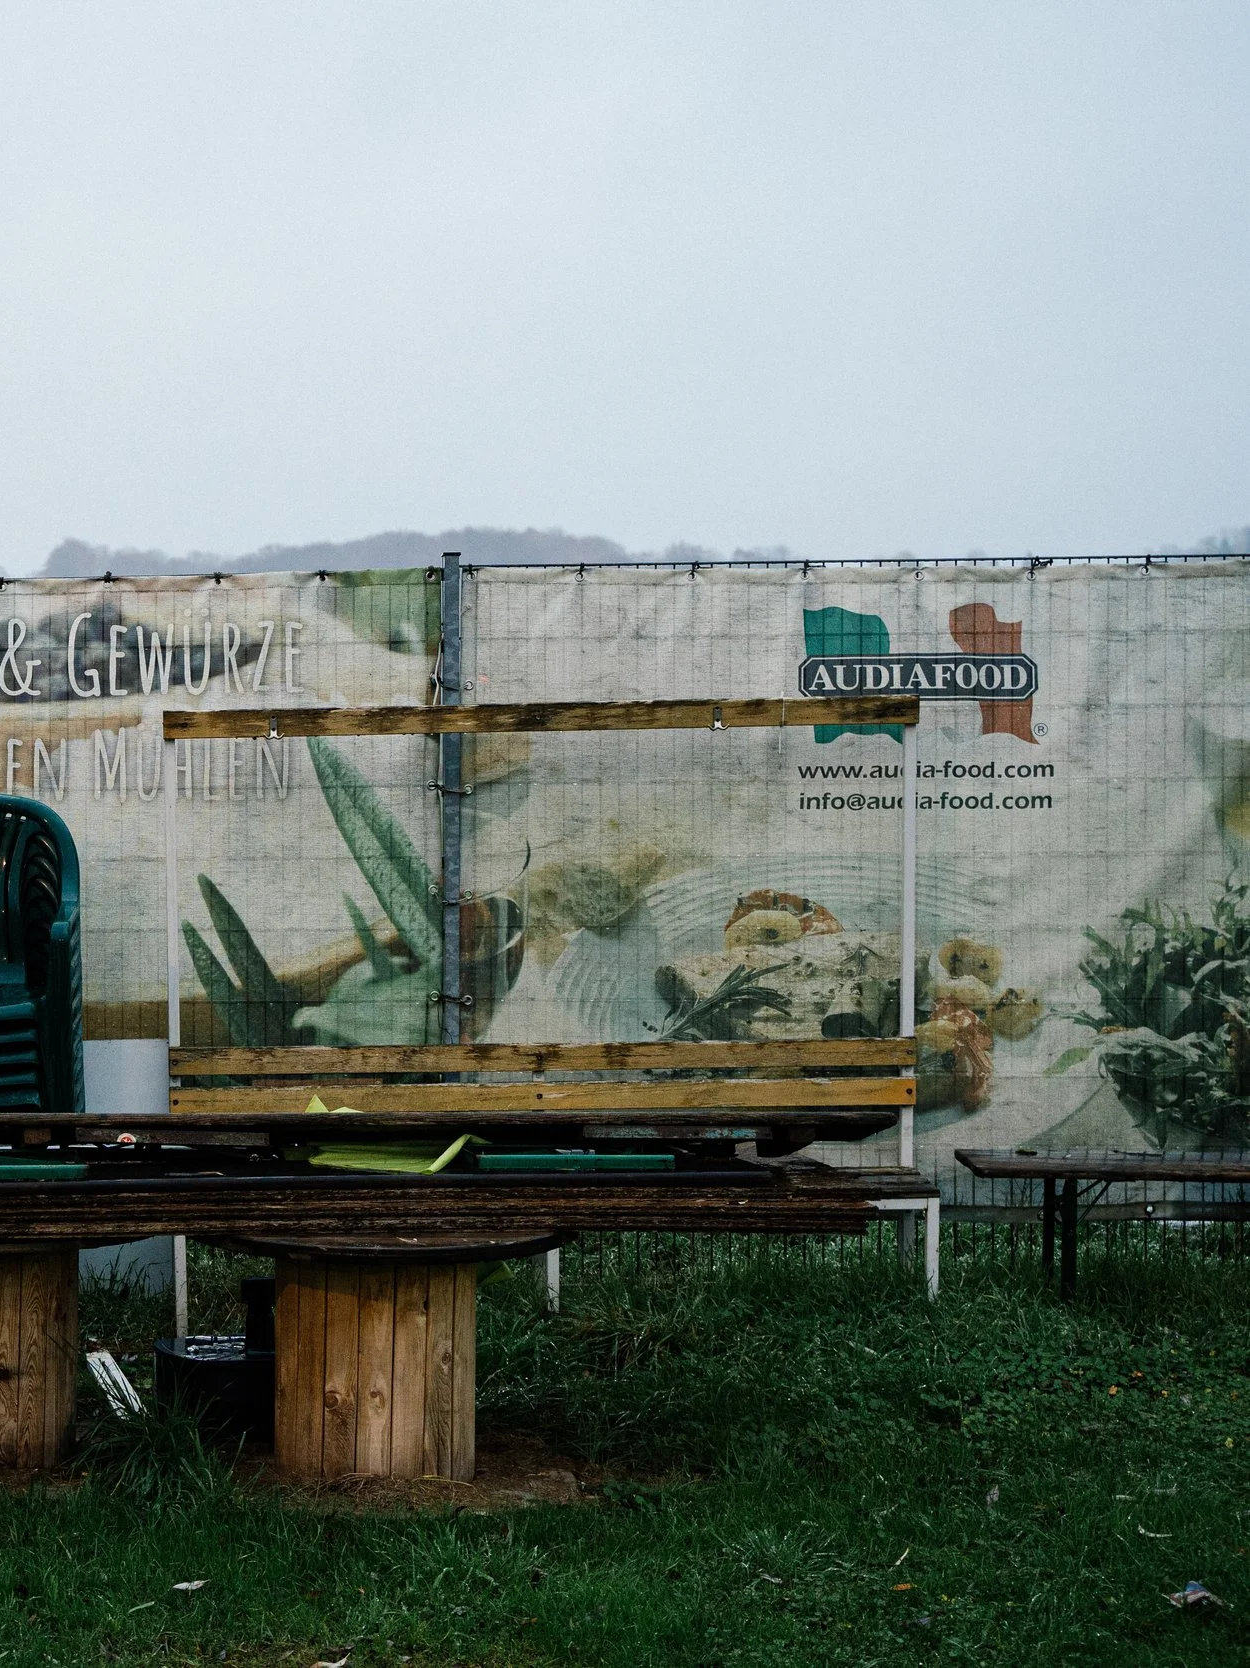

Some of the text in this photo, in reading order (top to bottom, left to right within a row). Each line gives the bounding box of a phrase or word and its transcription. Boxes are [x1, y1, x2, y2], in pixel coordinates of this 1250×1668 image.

[67, 608, 305, 698] GEWÜRZE
[809, 663, 1028, 691] AUDIAFOOD
[797, 760, 1055, 779] www.auia-food.com
